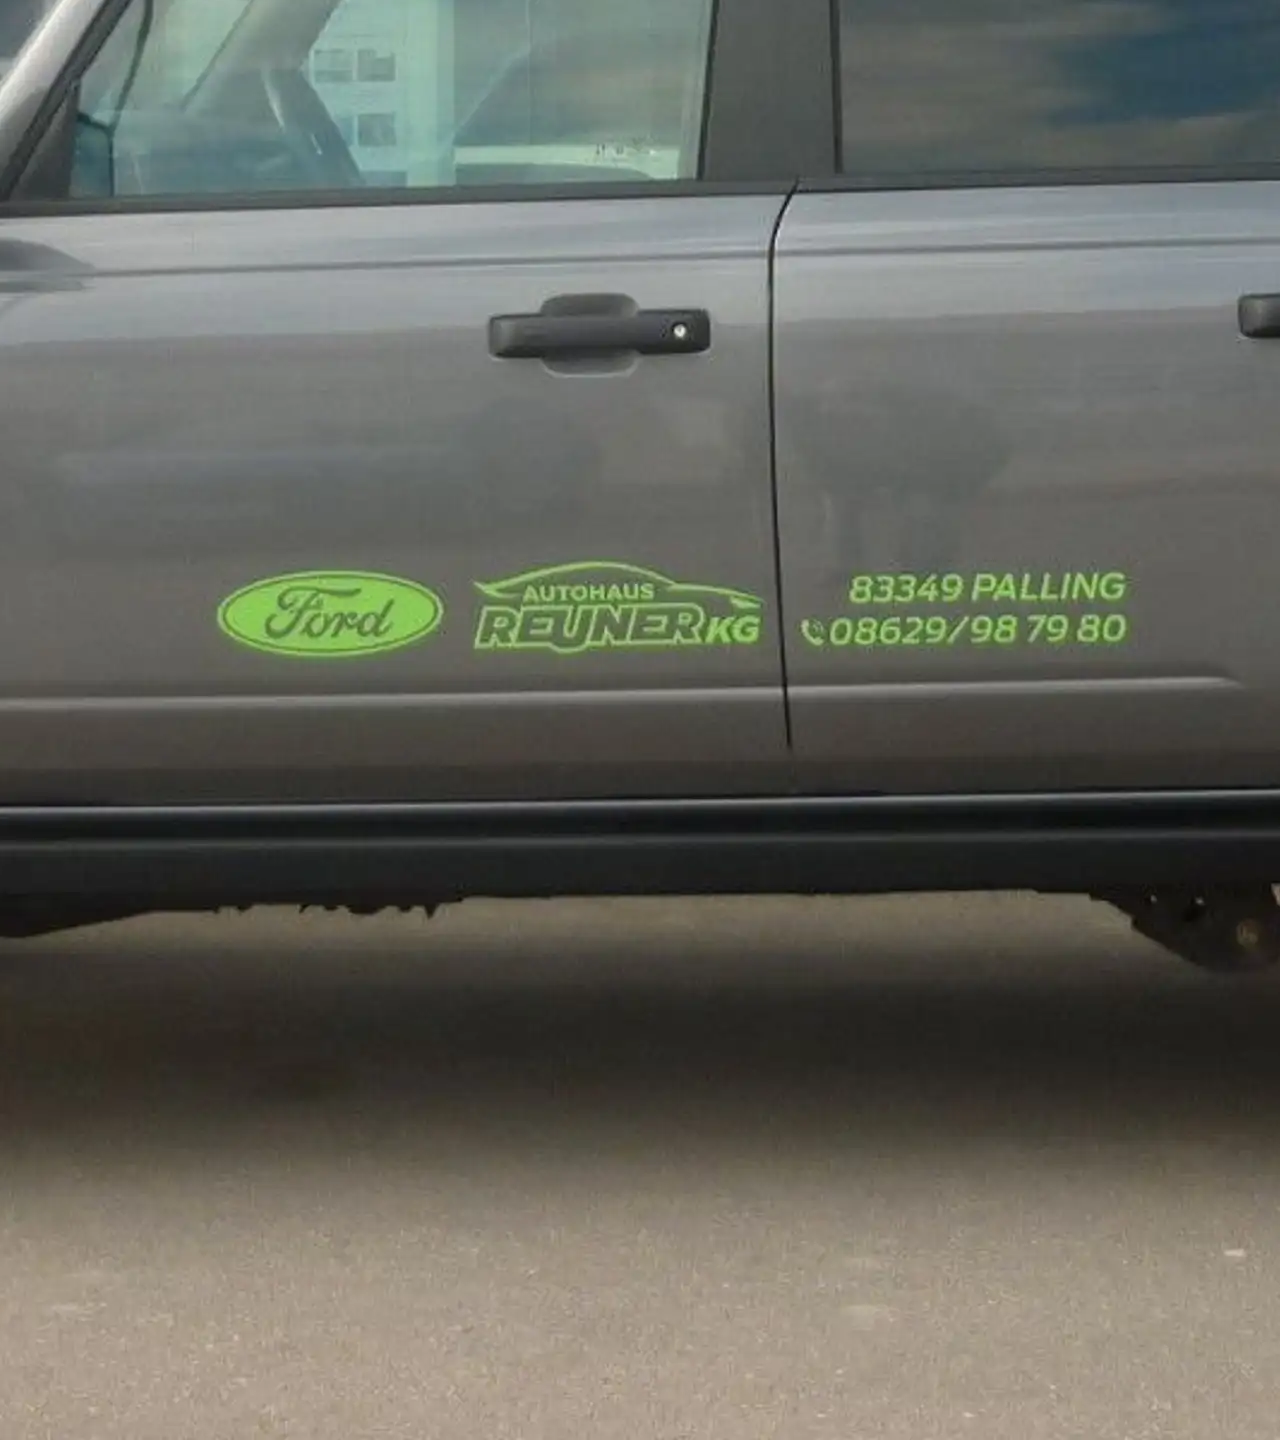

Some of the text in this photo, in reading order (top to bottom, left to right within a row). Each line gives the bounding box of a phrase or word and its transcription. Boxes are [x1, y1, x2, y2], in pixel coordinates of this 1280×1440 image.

[523, 583, 655, 602] AUTOHAUS
[849, 572, 1126, 603] 83349 PALLING
[265, 586, 395, 639] Ford
[829, 614, 1126, 645] 08629/98 79 80
